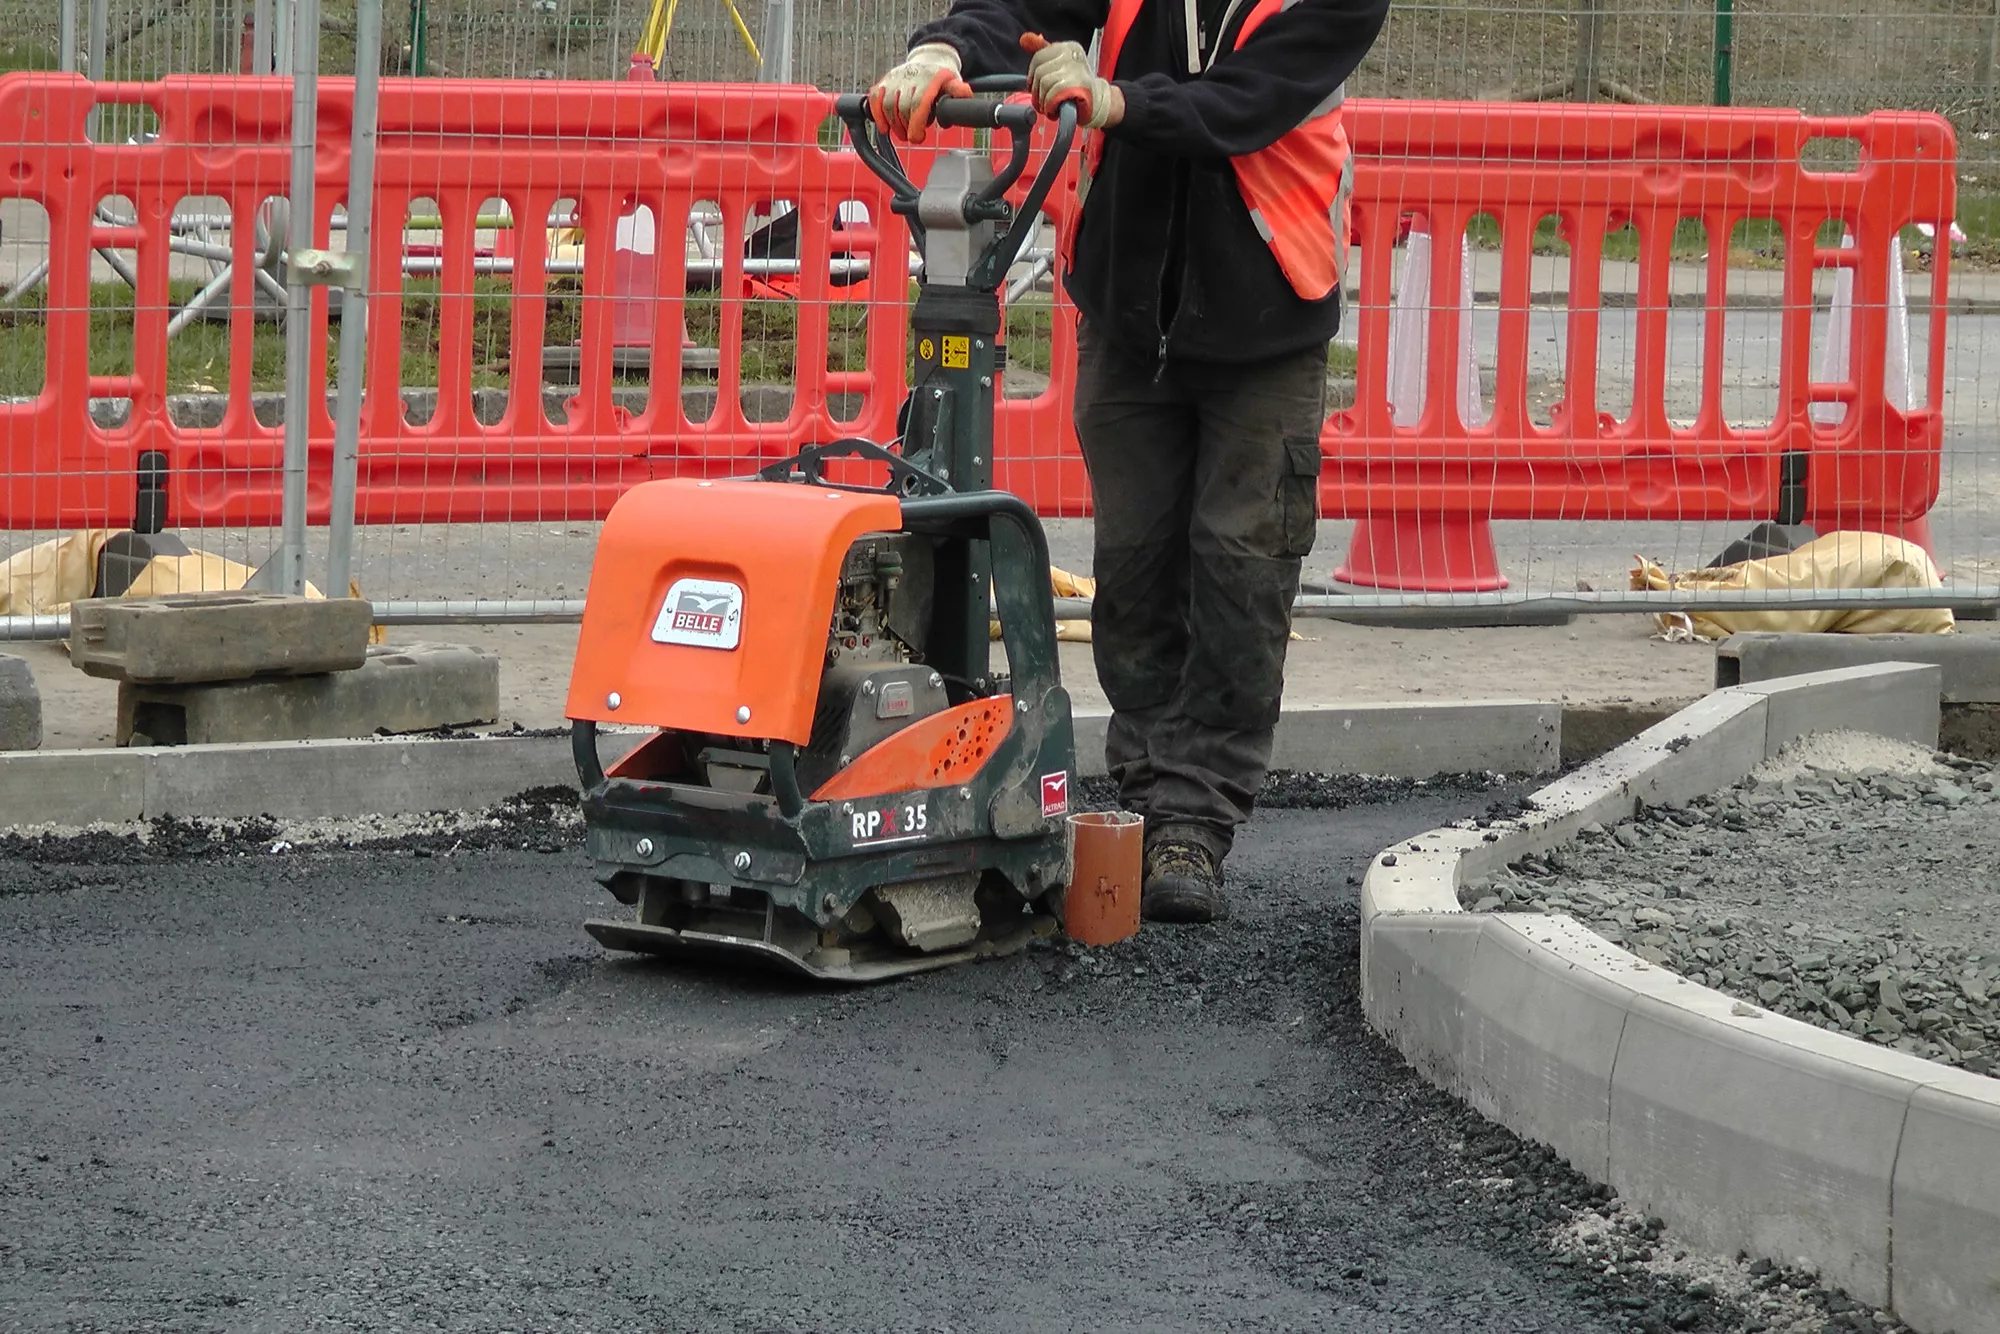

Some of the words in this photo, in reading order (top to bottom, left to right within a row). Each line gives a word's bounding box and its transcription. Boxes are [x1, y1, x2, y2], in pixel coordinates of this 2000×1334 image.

[675, 614, 720, 631] BELLE
[1044, 801, 1065, 813] ALTRAD
[853, 808, 897, 838] RPX
[904, 804, 927, 831] 35
